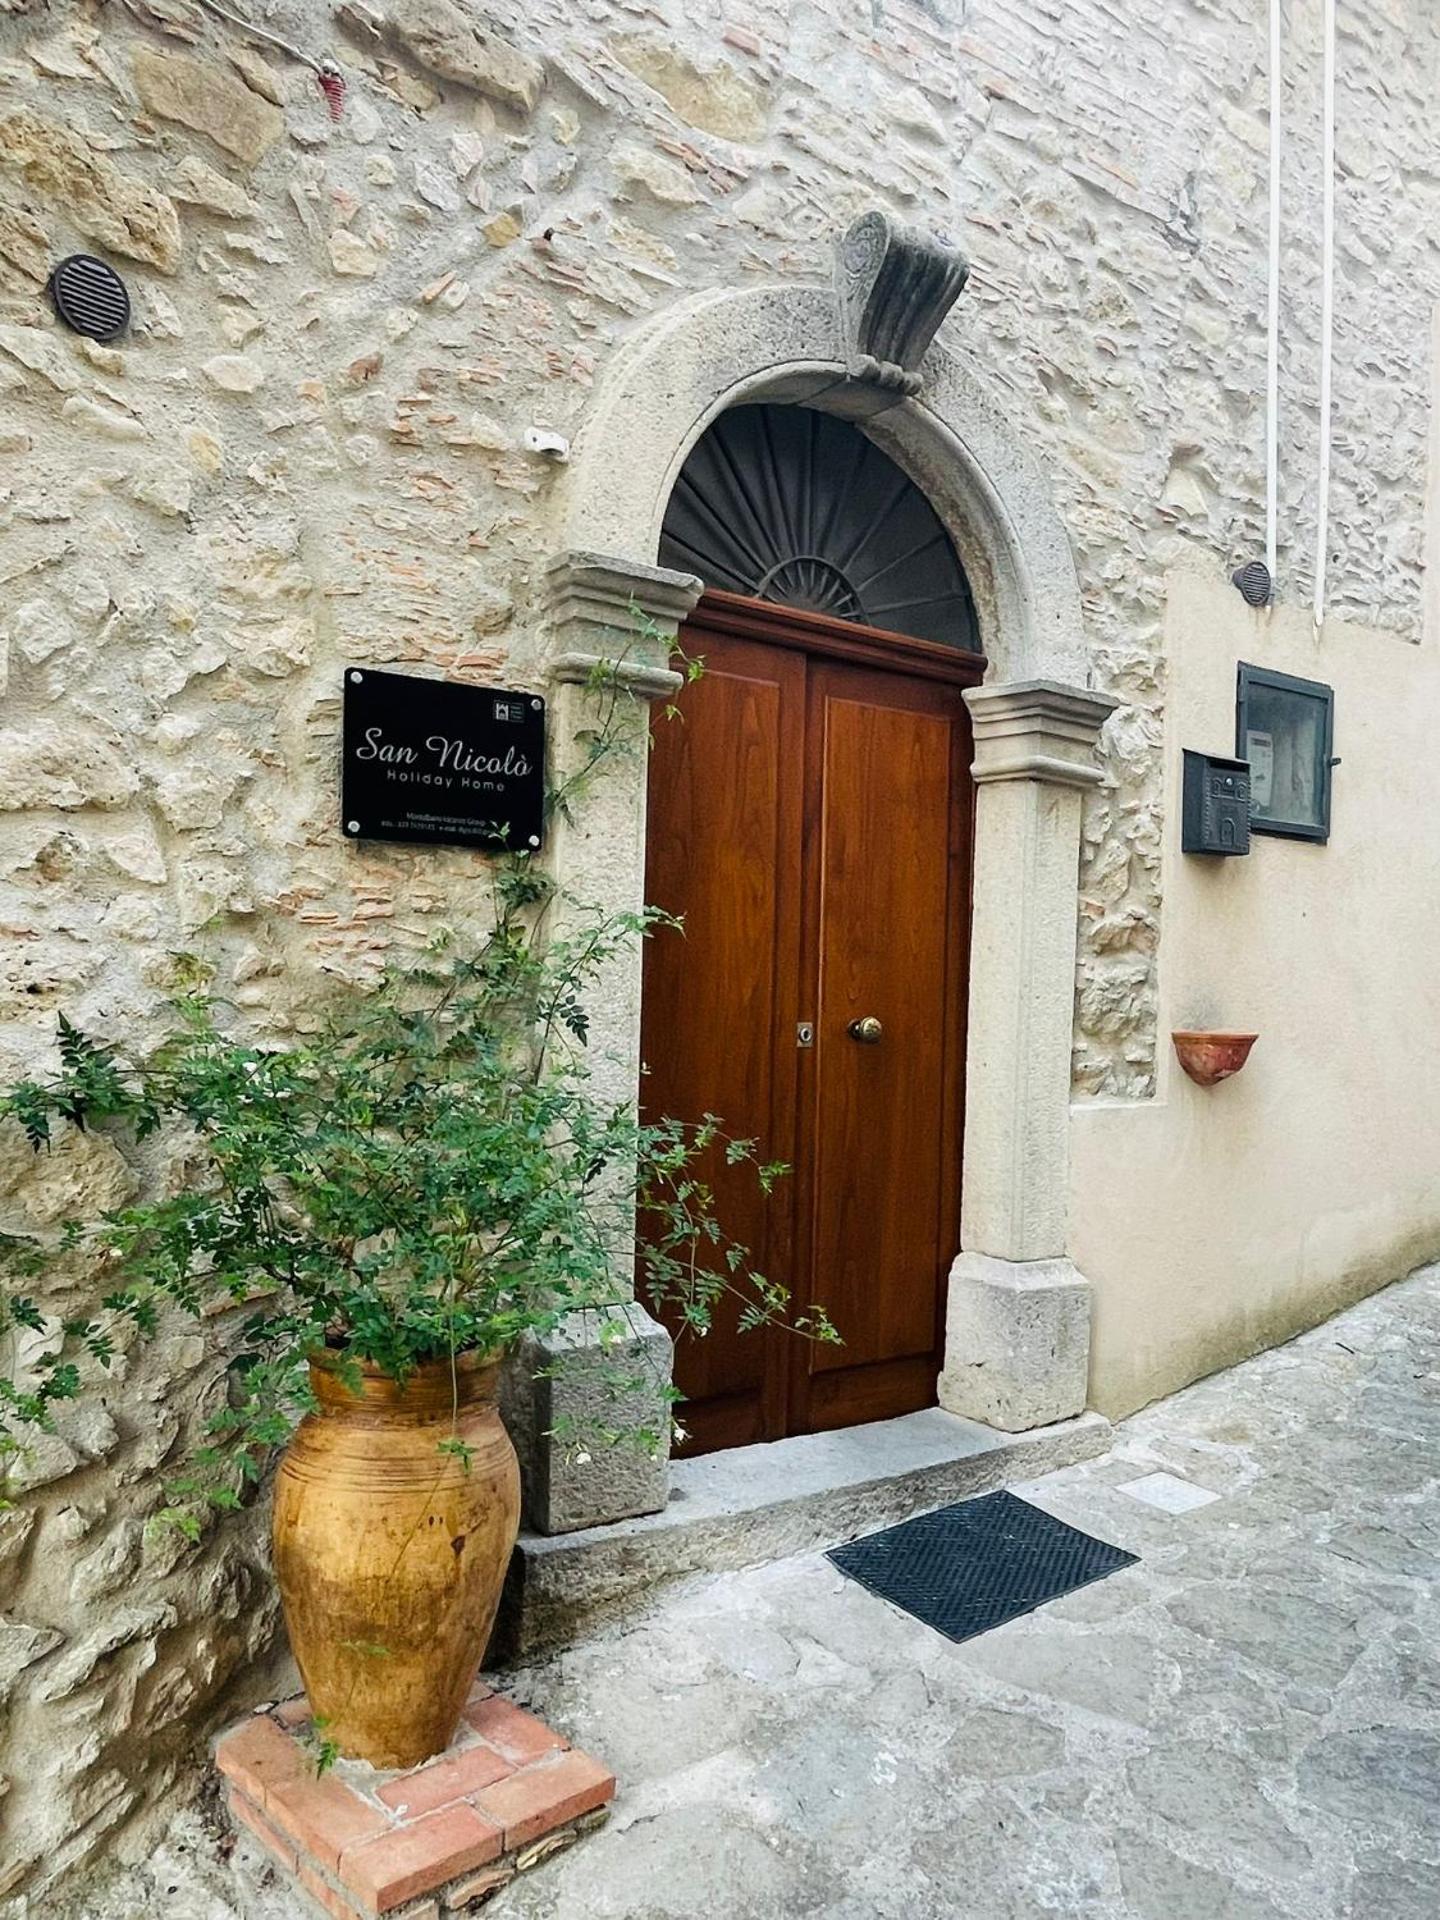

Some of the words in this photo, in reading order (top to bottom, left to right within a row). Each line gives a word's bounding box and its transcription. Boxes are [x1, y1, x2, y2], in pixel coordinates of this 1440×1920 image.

[356, 727, 418, 764] San
[425, 736, 533, 776] Nicolò
[387, 769, 453, 788] Holiday
[461, 777, 505, 792] Home
